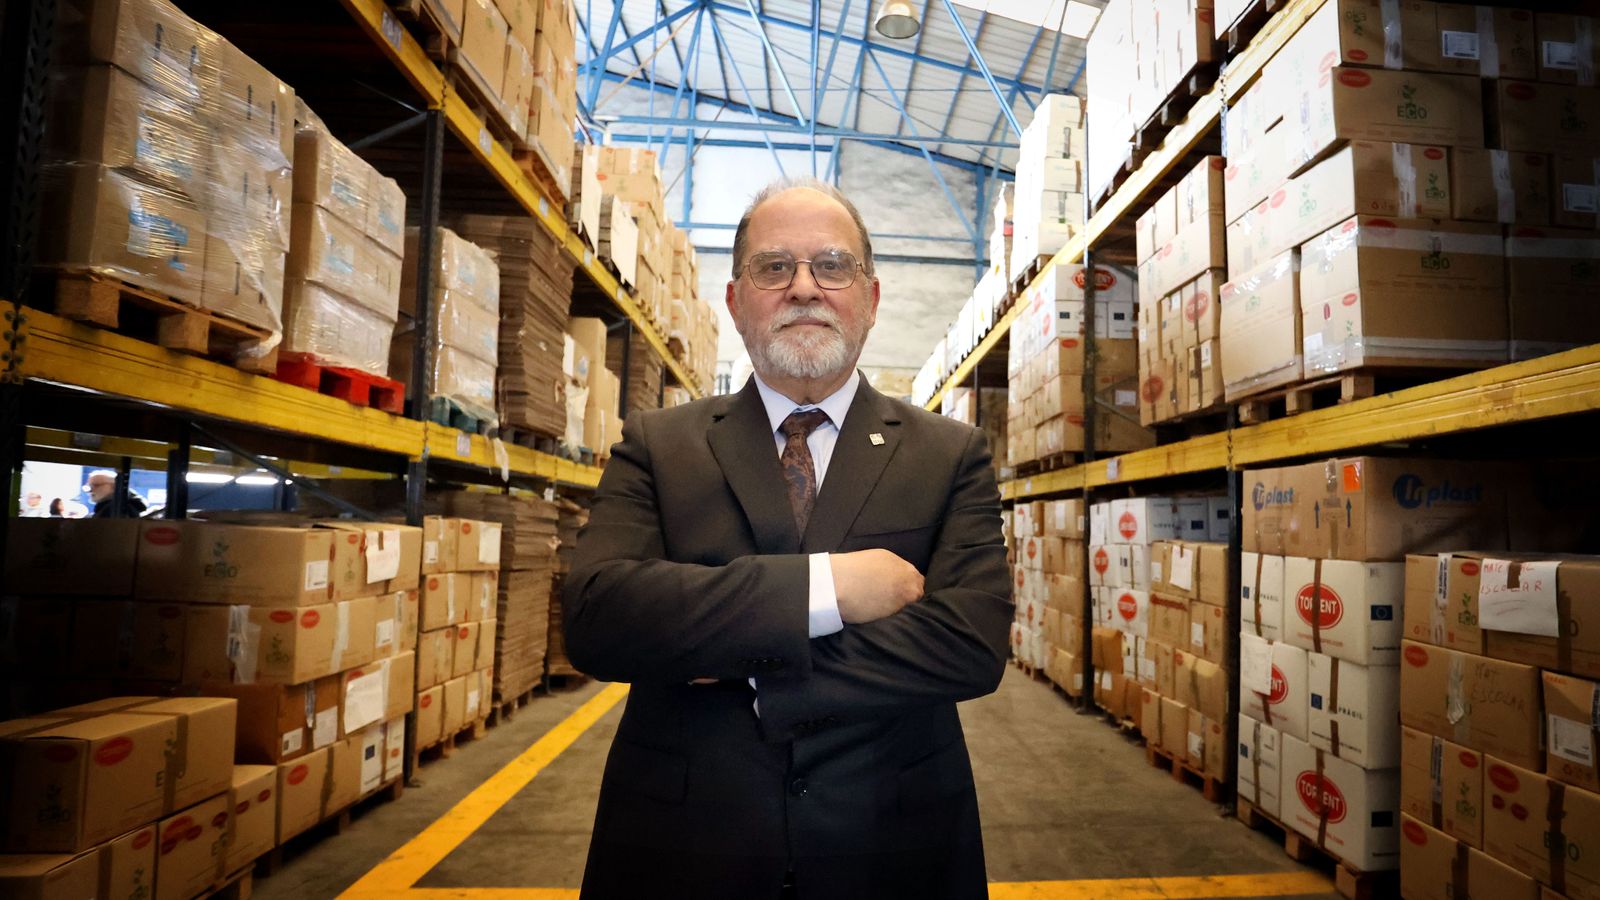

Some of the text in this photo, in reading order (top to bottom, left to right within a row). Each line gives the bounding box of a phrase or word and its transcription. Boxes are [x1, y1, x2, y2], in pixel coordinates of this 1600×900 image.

[1483, 562, 1535, 574] MATEAL
[1300, 595, 1337, 615] TOENT
[1301, 780, 1340, 810] TORENT
[1543, 830, 1580, 862] EO
